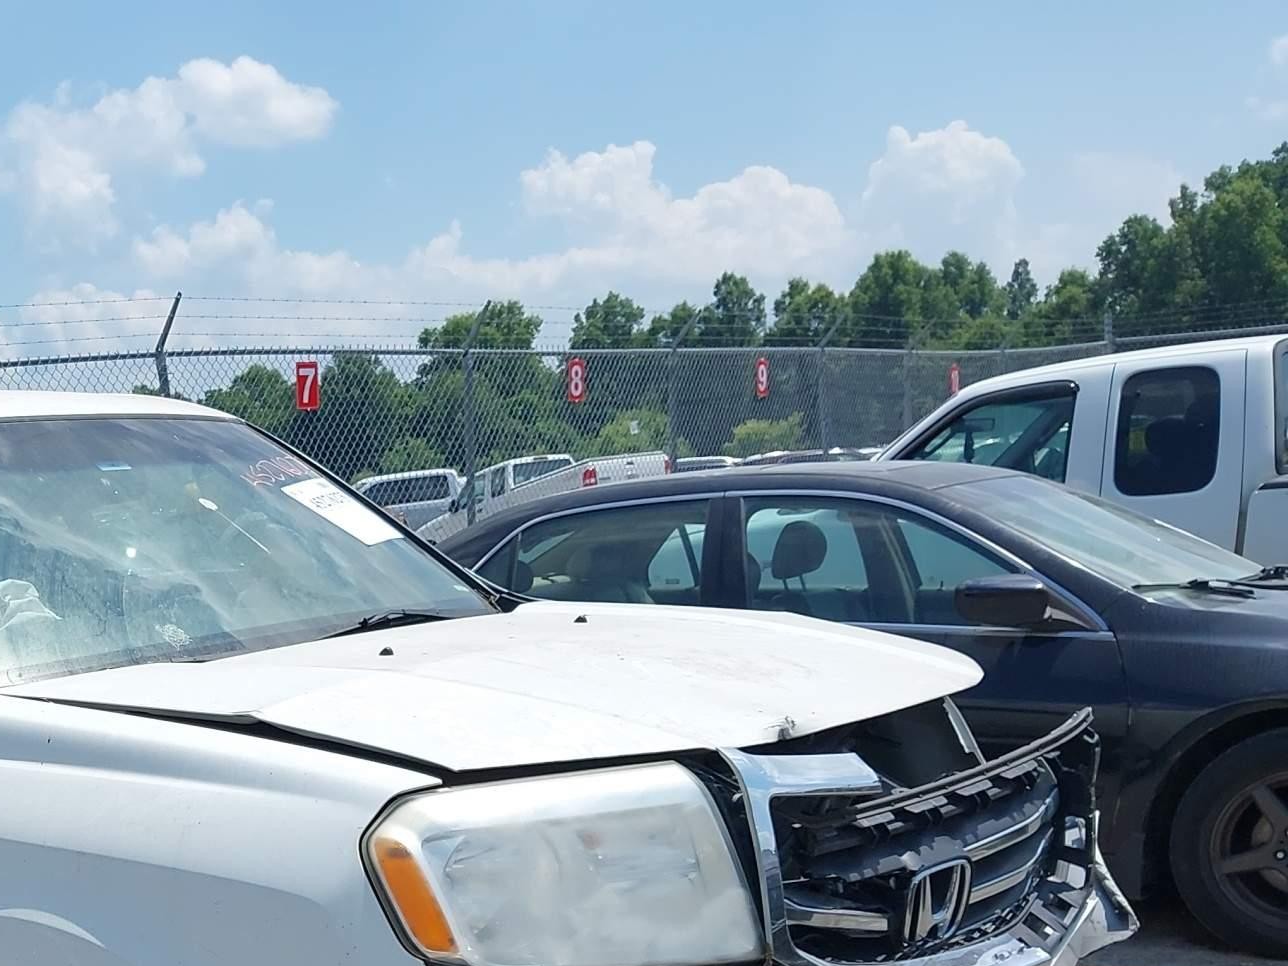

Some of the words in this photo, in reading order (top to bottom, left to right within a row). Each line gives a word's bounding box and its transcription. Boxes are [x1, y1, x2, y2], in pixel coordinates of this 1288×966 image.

[298, 367, 316, 404] 7
[571, 364, 583, 397] 8
[757, 363, 768, 391] 9
